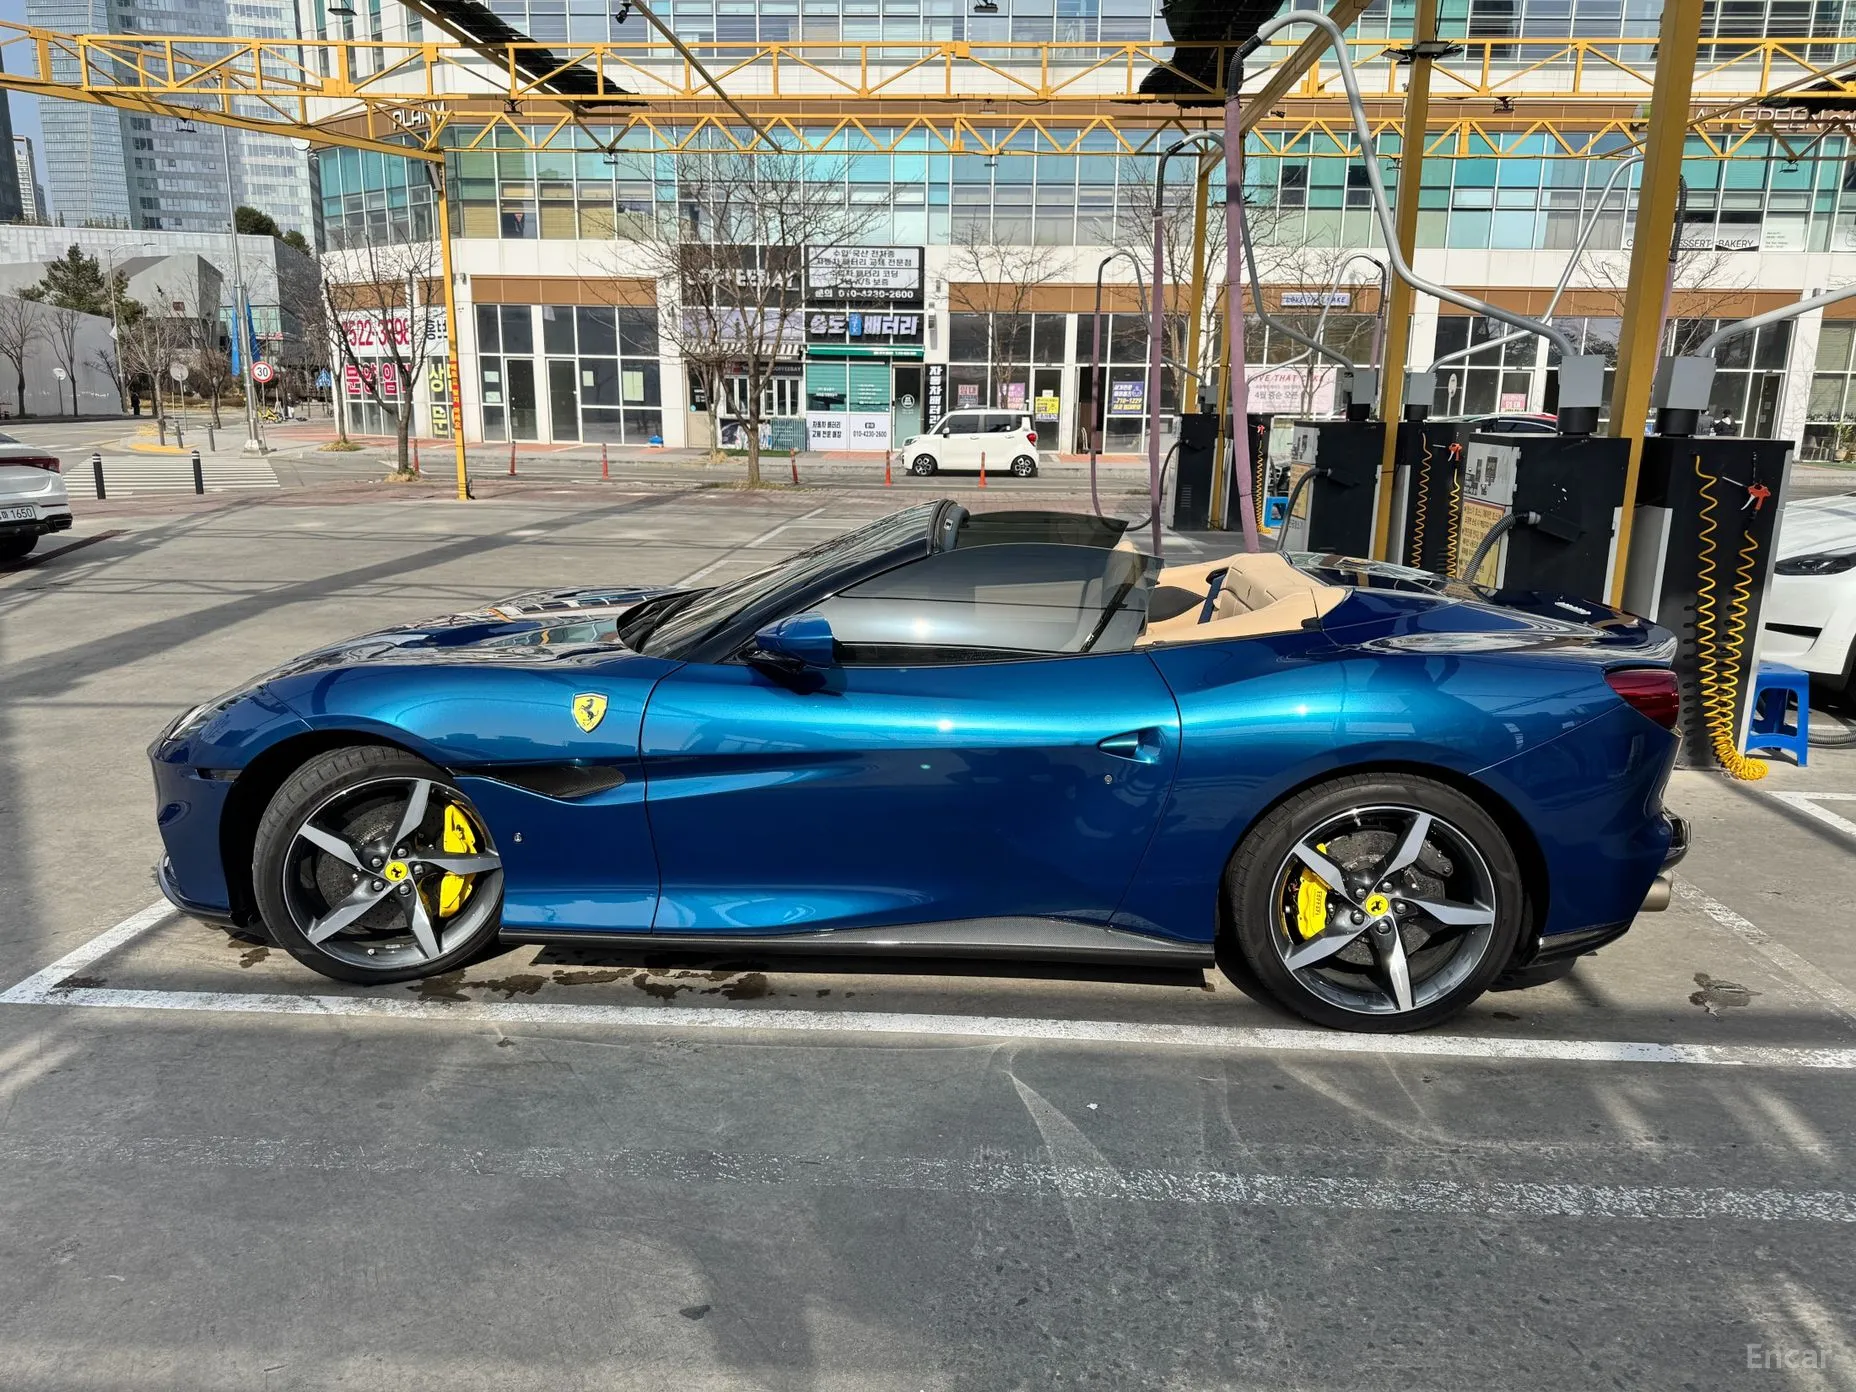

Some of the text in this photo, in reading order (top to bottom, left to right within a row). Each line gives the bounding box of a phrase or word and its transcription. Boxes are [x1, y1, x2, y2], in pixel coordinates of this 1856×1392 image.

[1678, 239, 1713, 248] ESSERT
[1718, 239, 1754, 248] BAKERY
[853, 249, 869, 257] 국산
[869, 258, 884, 266] 교체
[888, 258, 912, 267] 전문점
[882, 269, 899, 278] 코딩
[873, 278, 889, 286] 보증
[810, 314, 846, 334] 송도
[256, 366, 269, 377] 30
[1274, 374, 1298, 382] THAT
[11, 508, 33, 519] 1650
